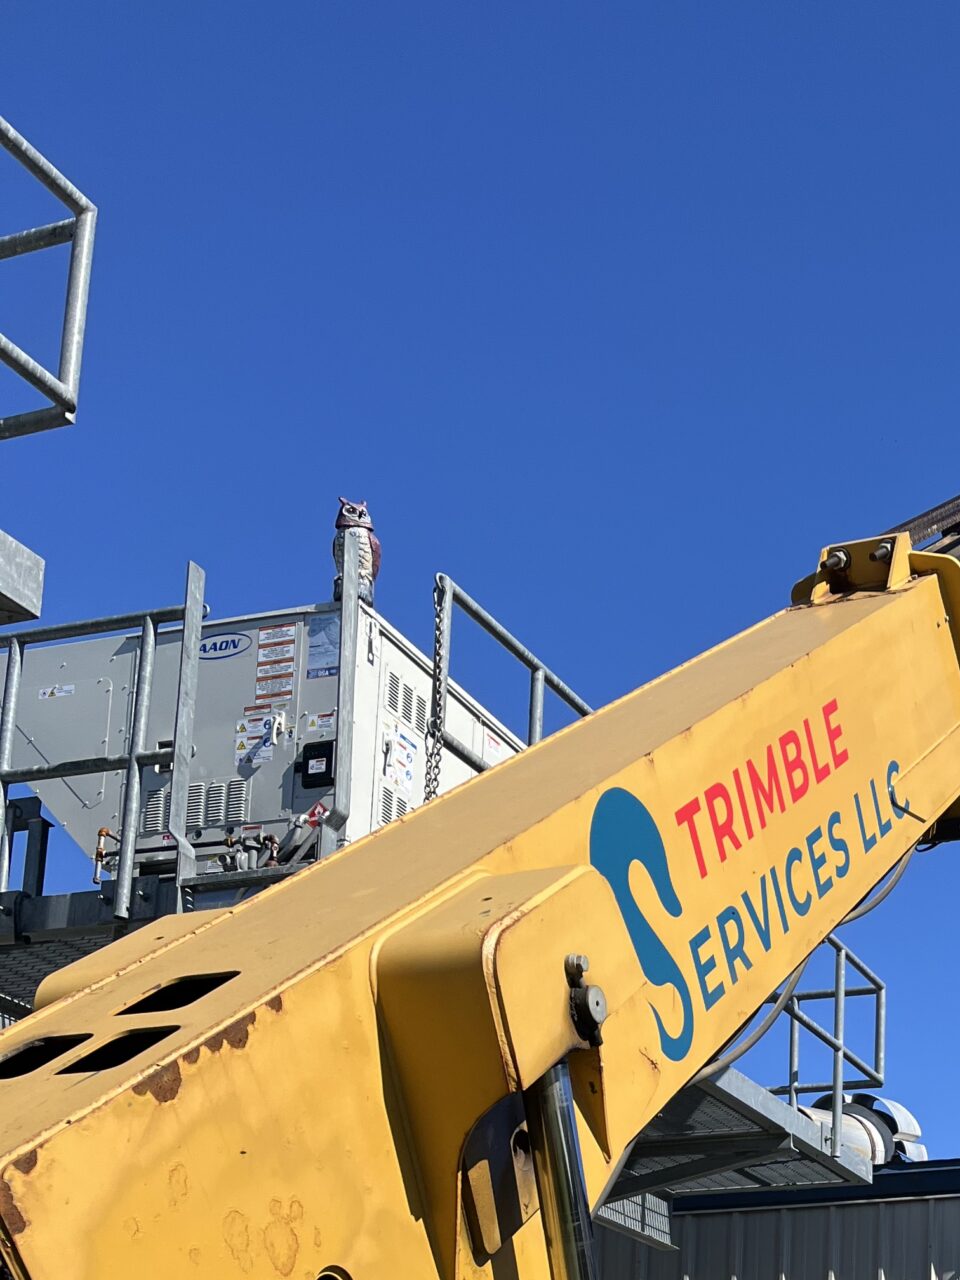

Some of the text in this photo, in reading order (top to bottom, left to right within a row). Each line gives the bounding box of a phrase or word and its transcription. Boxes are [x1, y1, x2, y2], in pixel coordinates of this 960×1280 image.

[199, 638, 242, 654] AAON
[674, 698, 849, 879] TRIMBLE
[589, 760, 910, 1062] SERVICES LLC
